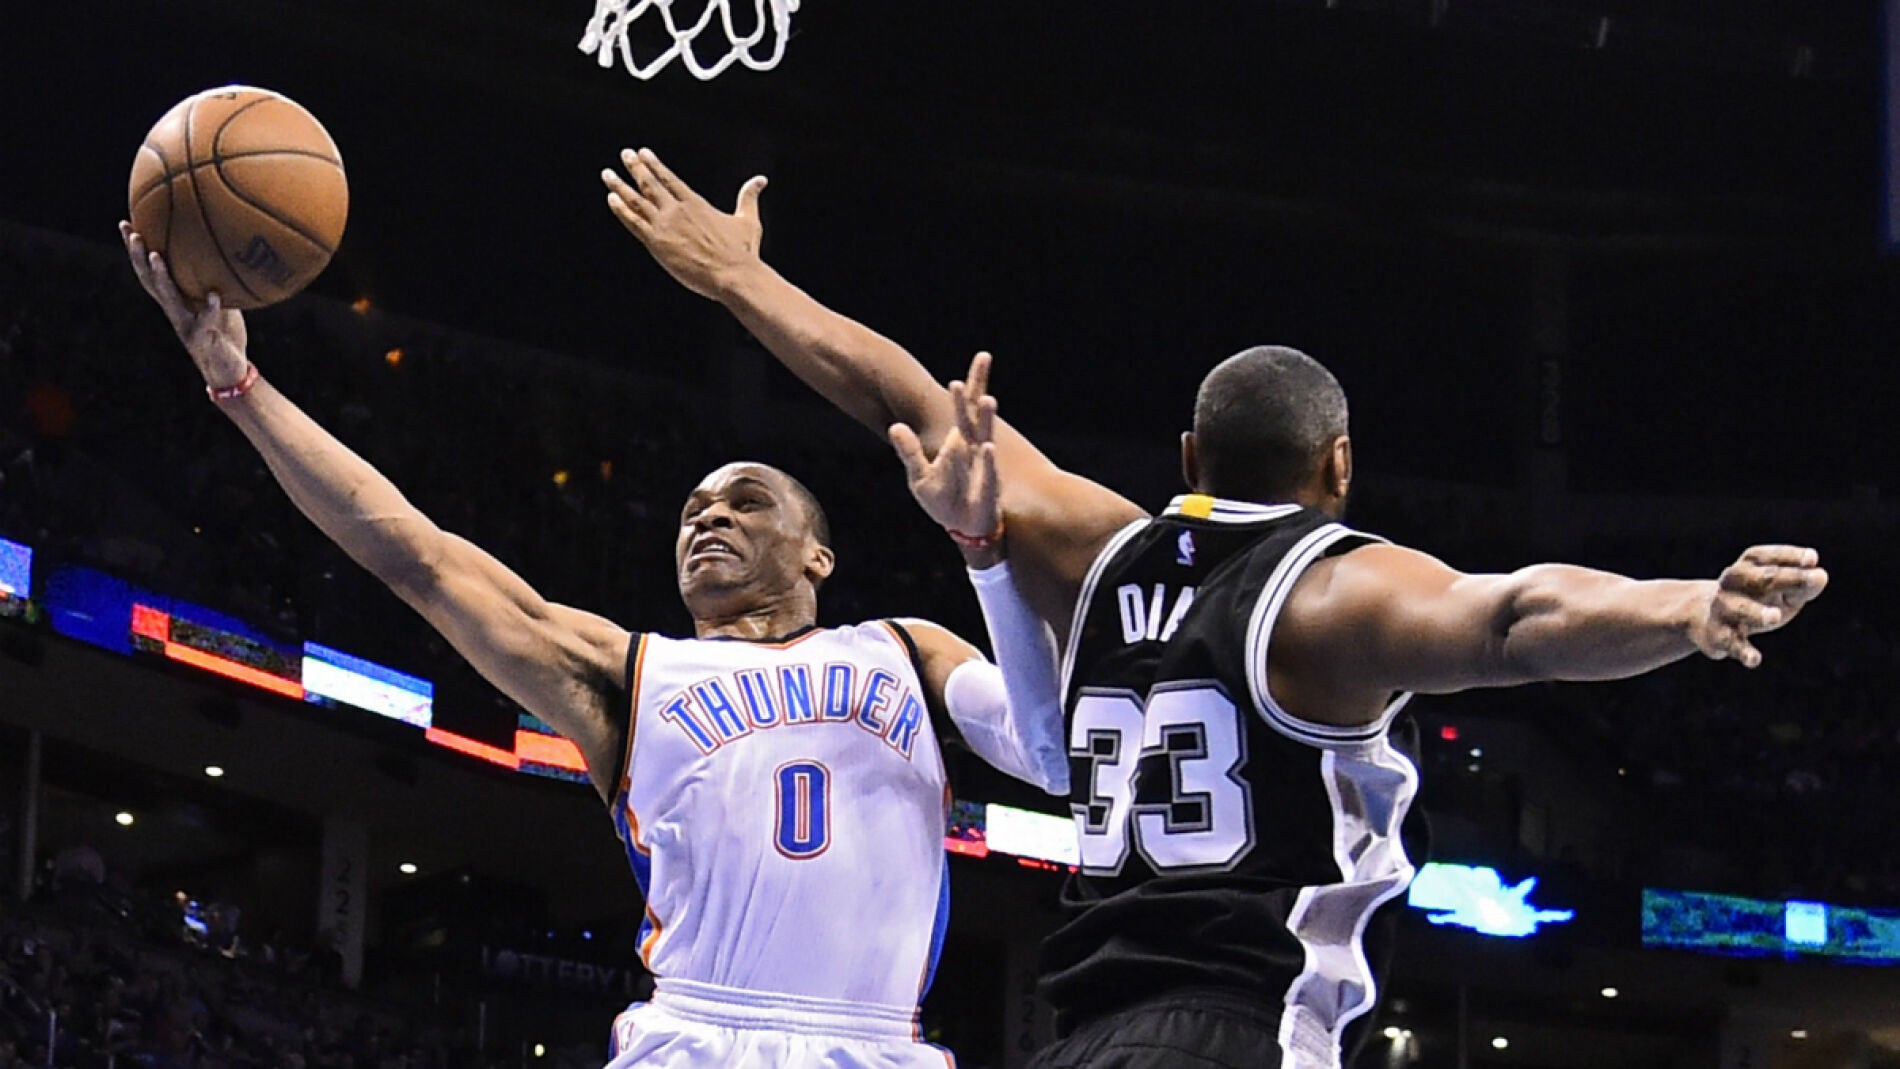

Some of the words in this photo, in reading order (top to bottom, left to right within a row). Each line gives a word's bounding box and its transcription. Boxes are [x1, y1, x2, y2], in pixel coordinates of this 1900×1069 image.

[660, 662, 922, 760] THUNDER
[774, 759, 831, 860] 0
[1069, 678, 1257, 877] 33
